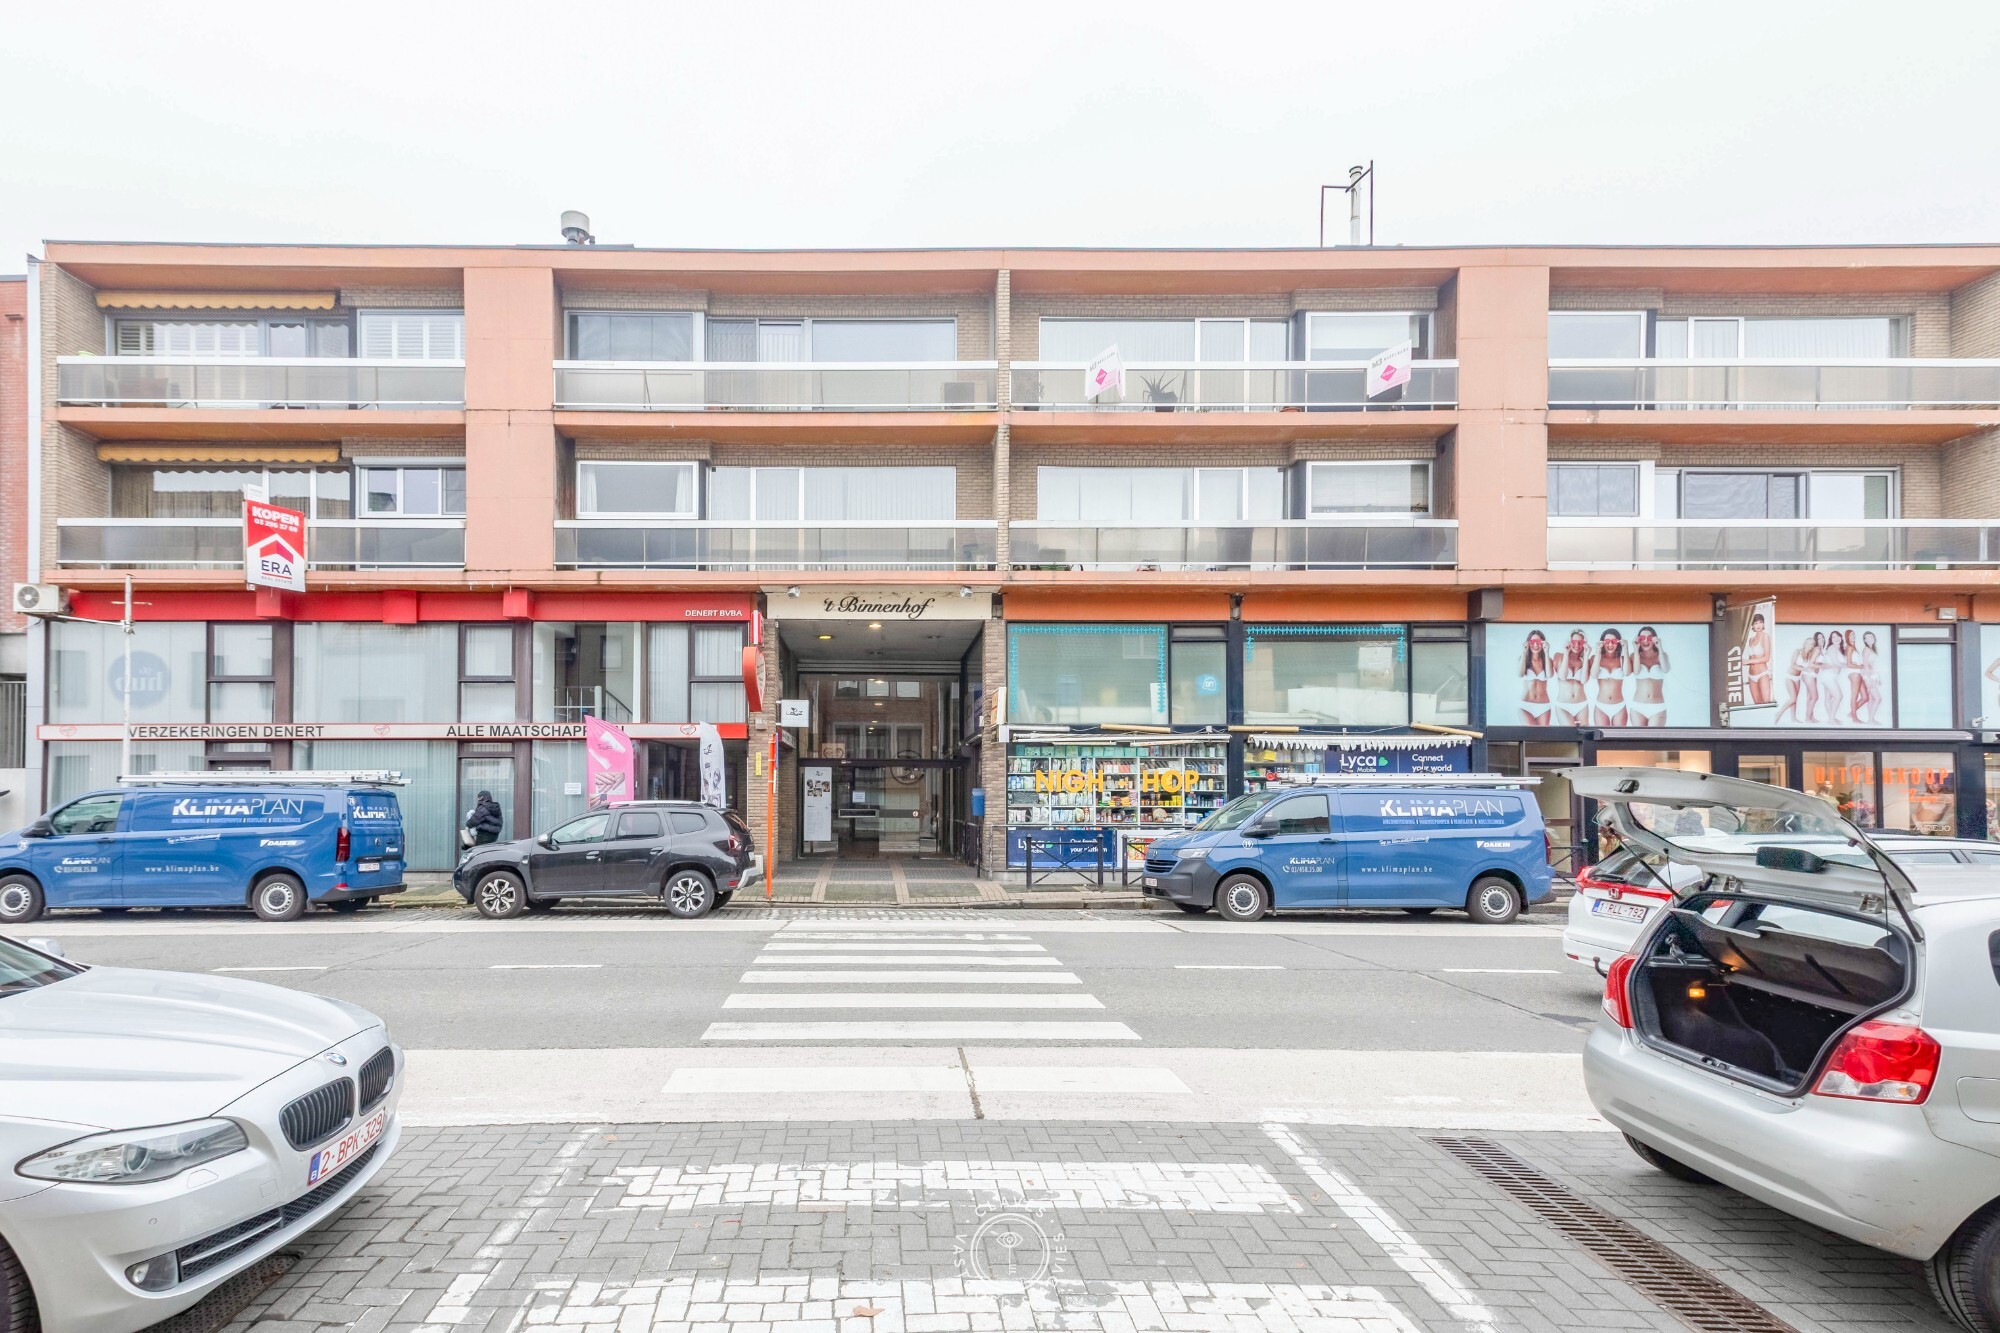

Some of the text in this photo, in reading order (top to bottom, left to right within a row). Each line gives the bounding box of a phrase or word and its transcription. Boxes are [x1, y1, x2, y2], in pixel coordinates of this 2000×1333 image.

[252, 506, 300, 527] KOPEN
[261, 559, 292, 576] ERA
[685, 609, 743, 617] DENERT BVBA
[838, 596, 936, 620] Binnenhof
[129, 726, 324, 738] VERZEKERINGEN DENERT
[446, 725, 485, 737] ALLE
[1341, 753, 1377, 769] Lyca
[1412, 754, 1443, 762] Connect
[1412, 764, 1452, 773] your world
[1035, 769, 1199, 793] NIGH HOP
[1814, 767, 1949, 785] UITVERKOOP
[172, 798, 304, 816] KLIMAPLAN
[1380, 800, 1504, 817] KLIMAPLAN
[1289, 857, 1335, 865] KLIMAPLAN
[144, 864, 220, 874] www.klimaplan.be
[1361, 866, 1433, 875] www.klimaplan.be
